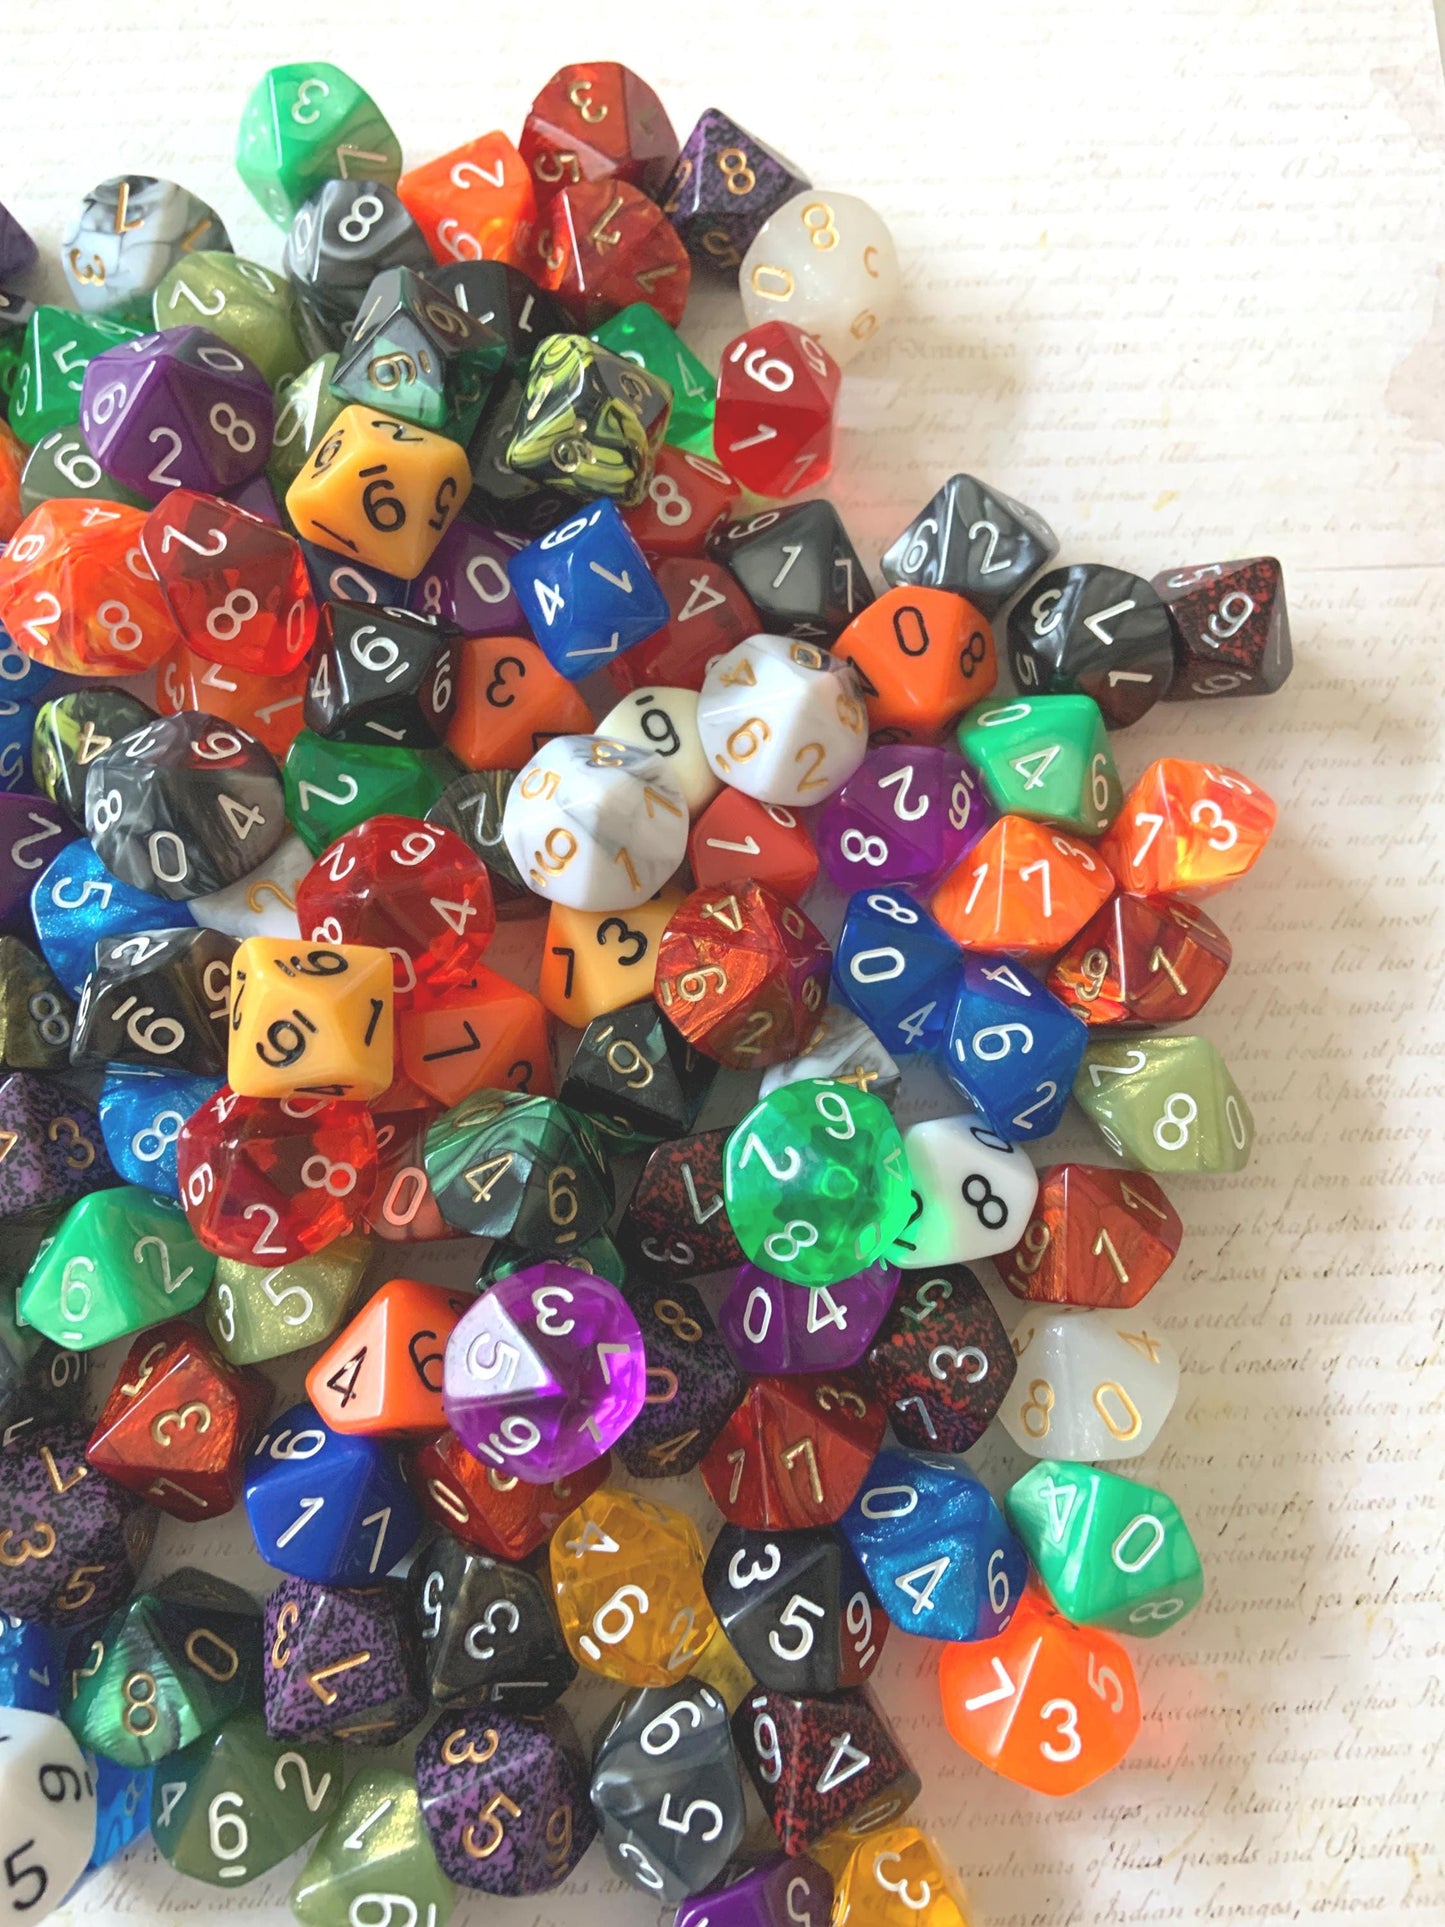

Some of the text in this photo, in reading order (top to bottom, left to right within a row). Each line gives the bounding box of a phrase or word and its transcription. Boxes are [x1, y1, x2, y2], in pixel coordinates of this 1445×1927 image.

[292, 79, 329, 123] 3
[570, 81, 607, 122] 3
[452, 160, 504, 188] 2
[534, 152, 580, 183] 5
[717, 149, 755, 195] 8
[338, 195, 383, 241] 8
[801, 203, 839, 250] 8
[70, 249, 105, 286] 3
[752, 263, 794, 301] 0
[170, 280, 225, 315] 2
[53, 340, 89, 390] 5
[210, 402, 256, 452] 8
[729, 424, 777, 452] 1
[148, 427, 182, 487] 2
[429, 477, 456, 530] 5
[649, 474, 691, 526] 8
[161, 525, 227, 557] 2
[969, 521, 1011, 574] 2
[466, 555, 511, 603] 0
[773, 545, 803, 588] 1
[23, 591, 61, 645] 2
[206, 589, 258, 640] 8
[534, 579, 565, 626] 4
[678, 574, 726, 622] 4
[1030, 589, 1062, 635] 3
[1084, 600, 1135, 645] 7
[97, 600, 143, 650] 8
[893, 606, 929, 656] 0
[720, 659, 757, 687] 4
[960, 631, 985, 678] 8
[311, 654, 331, 708] 4
[486, 656, 526, 708] 3
[77, 721, 112, 765] 4
[122, 727, 155, 758] 2
[795, 742, 829, 792] 2
[299, 774, 358, 811] 2
[520, 767, 562, 800] 5
[879, 765, 929, 821] 2
[1010, 746, 1060, 791] 4
[93, 789, 123, 833] 8
[218, 794, 266, 839] 4
[458, 792, 503, 846] 2
[1191, 799, 1237, 851] 3
[11, 812, 61, 870] 2
[149, 830, 188, 883] 0
[320, 843, 355, 881] 2
[840, 829, 888, 866] 8
[1053, 836, 1096, 870] 3
[1132, 813, 1163, 867] 7
[51, 877, 112, 910] 5
[867, 895, 919, 925] 8
[1021, 860, 1053, 916] 7
[431, 897, 477, 935] 4
[702, 895, 743, 932] 4
[111, 937, 169, 966] 2
[597, 918, 648, 966] 3
[850, 947, 905, 983] 0
[552, 947, 574, 998] 7
[981, 965, 1031, 997] 4
[30, 991, 69, 1045] 8
[365, 998, 383, 1046] 1
[733, 1011, 773, 1054] 2
[898, 1001, 936, 1045] 4
[1089, 1051, 1146, 1088] 2
[1012, 1081, 1057, 1129] 2
[1152, 1092, 1197, 1150] 8
[1226, 1095, 1245, 1149] 0
[50, 1116, 95, 1170] 3
[132, 1110, 185, 1161] 8
[738, 1133, 799, 1180] 2
[301, 1154, 356, 1197] 8
[383, 1167, 427, 1226] 0
[463, 1152, 514, 1203] 4
[548, 1165, 578, 1244] 6
[962, 1173, 1008, 1230] 8
[244, 1204, 286, 1254] 2
[764, 1220, 818, 1262] 8
[134, 1236, 193, 1293] 2
[61, 1256, 95, 1340] 6
[218, 1284, 235, 1342] 3
[260, 1266, 313, 1325] 5
[531, 1286, 575, 1336] 3
[654, 1299, 703, 1341] 8
[743, 1287, 772, 1343] 0
[807, 1286, 847, 1333] 4
[1306, 1293, 1417, 1327] multitude
[327, 1346, 367, 1408] 4
[466, 1332, 520, 1390] 5
[928, 1344, 988, 1384] 3
[152, 1402, 211, 1446] 3
[816, 1384, 866, 1418] 3
[1020, 1379, 1054, 1438] 8
[1092, 1381, 1142, 1441] 0
[781, 1438, 823, 1503] 7
[276, 1497, 324, 1548] 1
[860, 1485, 918, 1519] 0
[1039, 1475, 1077, 1543] 4
[0, 1522, 56, 1566] 3
[362, 1507, 391, 1573] 7
[565, 1521, 620, 1558] 4
[1112, 1513, 1165, 1572] 0
[56, 1566, 105, 1610] 5
[728, 1544, 781, 1590] 3
[895, 1556, 951, 1615] 4
[465, 1599, 519, 1660] 3
[769, 1594, 824, 1661] 5
[1129, 1598, 1184, 1623] 8
[185, 1628, 239, 1682] 0
[272, 1602, 299, 1669] 3
[667, 1607, 697, 1670] 2
[122, 1671, 158, 1736] 8
[1088, 1653, 1123, 1712] 5
[441, 1729, 499, 1765] 3
[1040, 1698, 1082, 1763] 3
[274, 1752, 331, 1812] 2
[816, 1732, 870, 1793] 4
[208, 1791, 248, 1878] 6
[463, 1793, 521, 1858] 5
[659, 1793, 723, 1842] 5
[5, 1839, 47, 1912] 5
[619, 1843, 663, 1889] 3
[873, 1852, 930, 1910] 3
